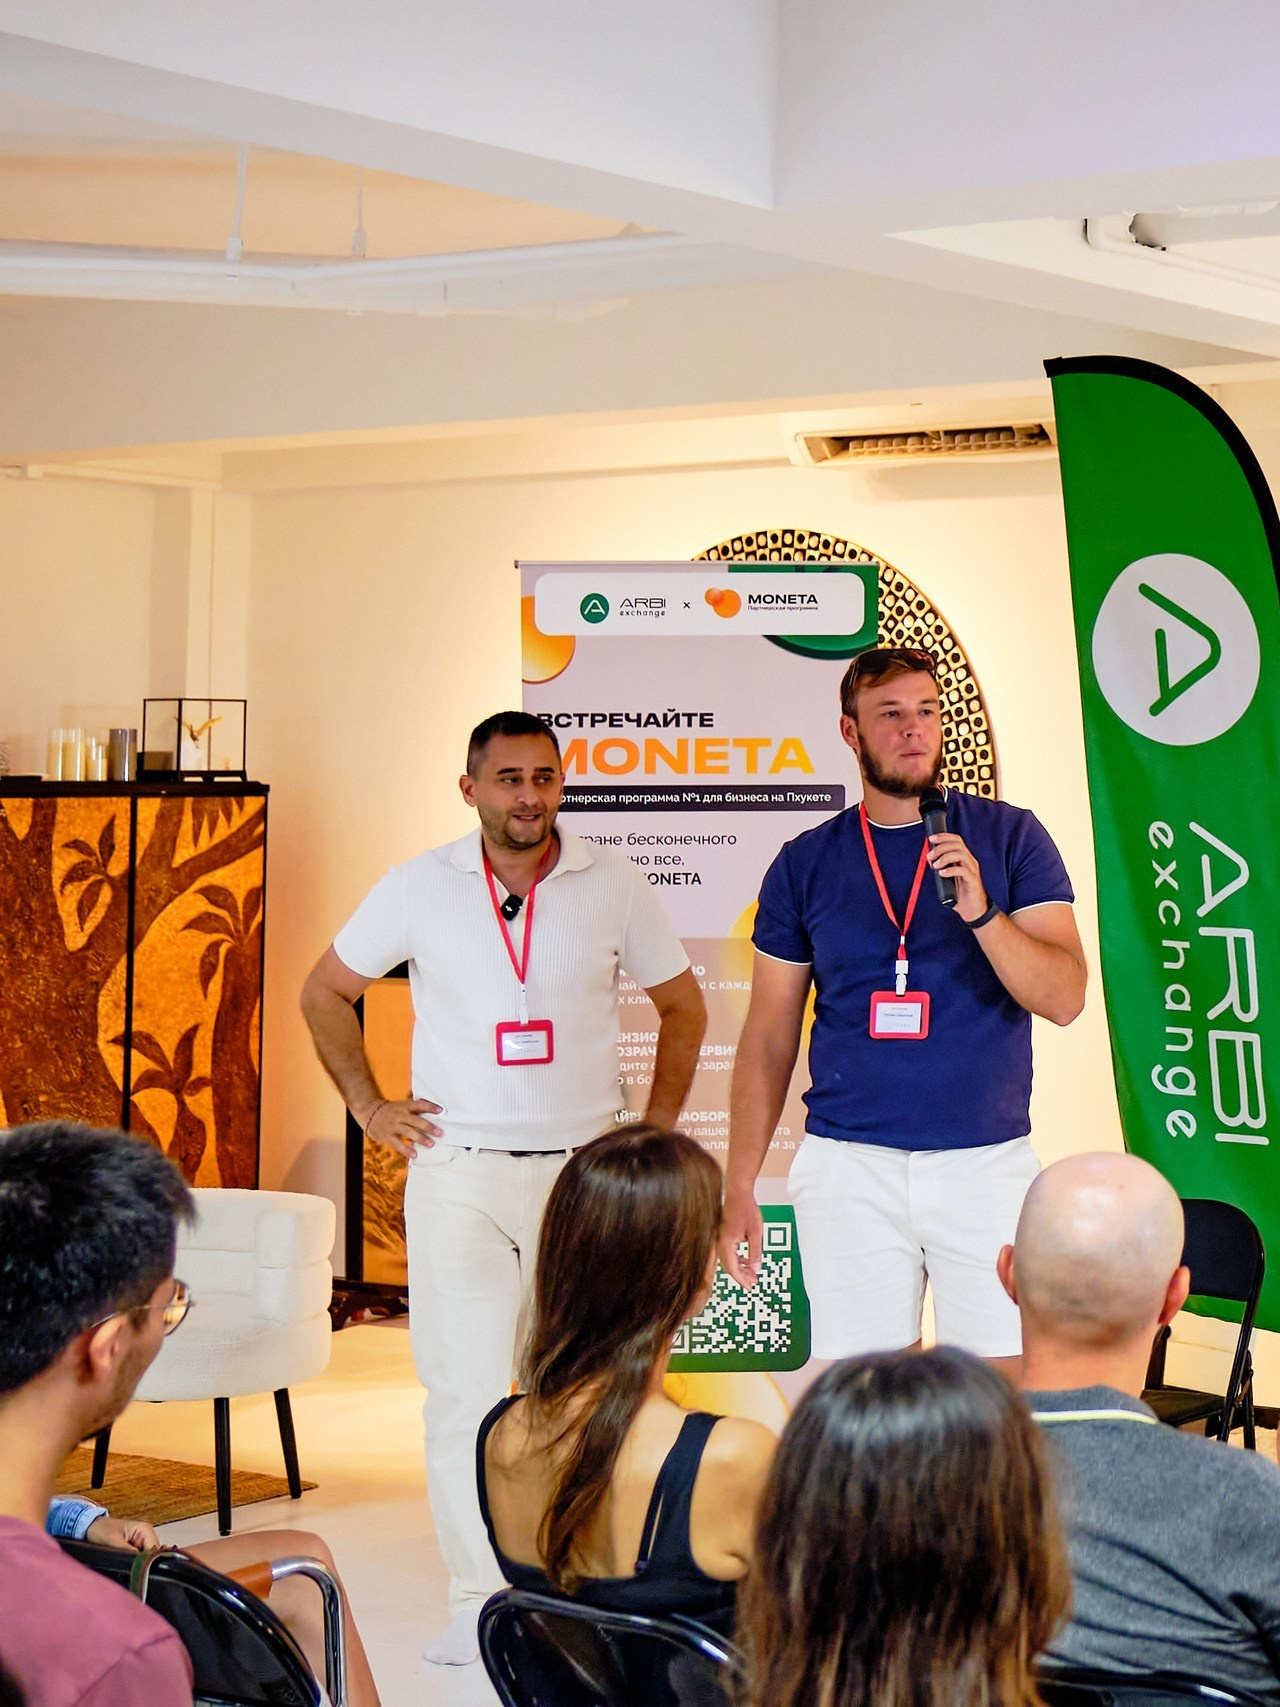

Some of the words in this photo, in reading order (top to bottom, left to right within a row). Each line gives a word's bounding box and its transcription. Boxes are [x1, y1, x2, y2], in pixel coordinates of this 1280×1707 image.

[619, 598, 666, 608] ARBI
[748, 594, 818, 604] MONETA
[619, 610, 666, 618] exchange
[619, 794, 680, 805] программа
[703, 793, 723, 804] для
[725, 791, 769, 802] бизнеса
[771, 793, 785, 802] на
[787, 791, 832, 804] Пхукете
[627, 832, 737, 846] бесконечного
[654, 855, 685, 867] все,
[645, 873, 702, 885] ONETA
[1149, 820, 1197, 1138] exchange
[1189, 821, 1269, 1146] ARBI
[719, 981, 752, 991] кажд
